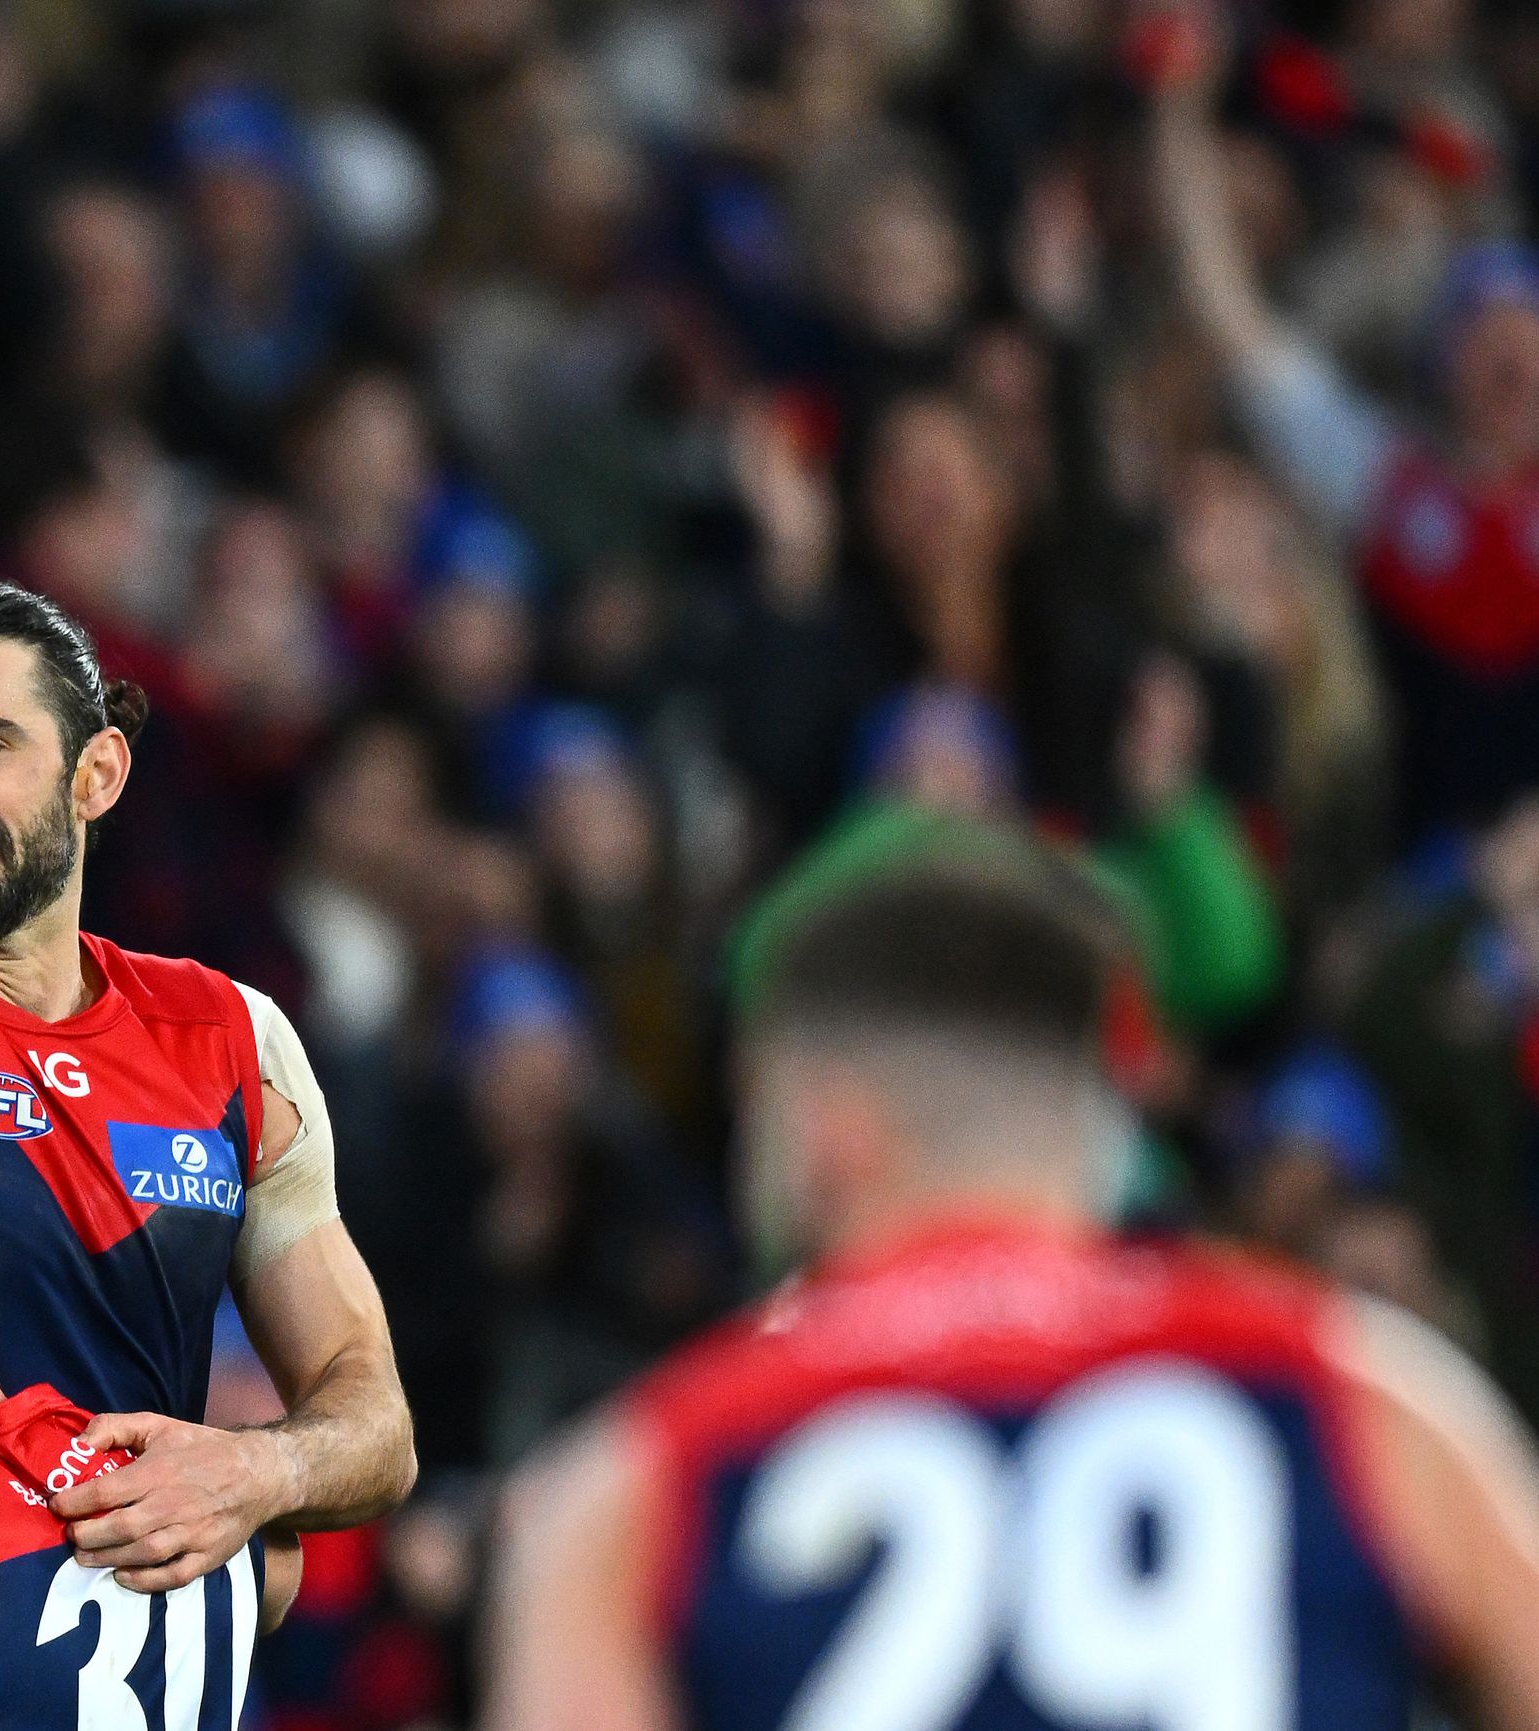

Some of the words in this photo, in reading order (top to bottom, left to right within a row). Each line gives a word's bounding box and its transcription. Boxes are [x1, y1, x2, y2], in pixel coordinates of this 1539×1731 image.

[27, 1050, 90, 1097] IG
[131, 1171, 242, 1211] ZURICH
[739, 1358, 1293, 1731] 29
